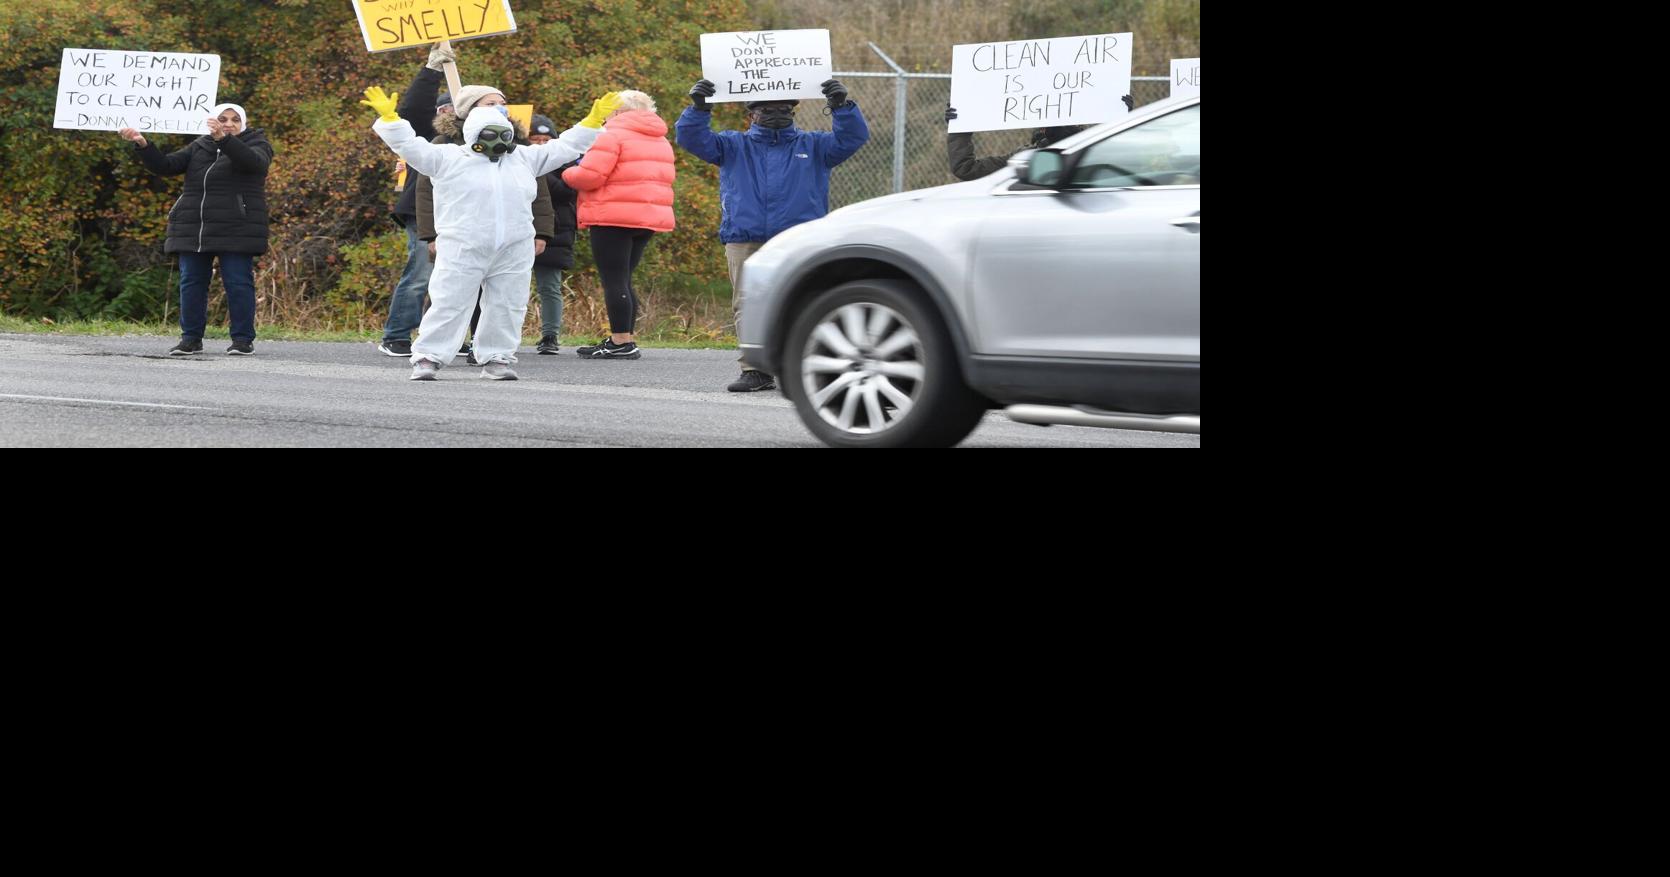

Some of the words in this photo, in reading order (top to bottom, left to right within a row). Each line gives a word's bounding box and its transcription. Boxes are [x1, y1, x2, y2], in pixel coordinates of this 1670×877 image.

[376, 0, 490, 44] SMELLY
[736, 32, 776, 45] WE
[69, 51, 108, 68] WE
[123, 54, 211, 72] DEMAND
[731, 45, 777, 58] DON'T
[972, 41, 1050, 72] CLEAN
[1073, 36, 1120, 64] AIR
[734, 57, 823, 69] APPRECIATE
[77, 72, 118, 87] OUR
[131, 73, 198, 91] RIGHT
[741, 69, 770, 79] THE
[1004, 74, 1024, 94] IS
[1052, 71, 1094, 90] OUR
[65, 91, 90, 106] TO
[97, 93, 162, 109] CLEAN
[172, 93, 210, 113] AIR
[1003, 91, 1079, 122] RIGHT
[139, 115, 203, 132] SKELLY
